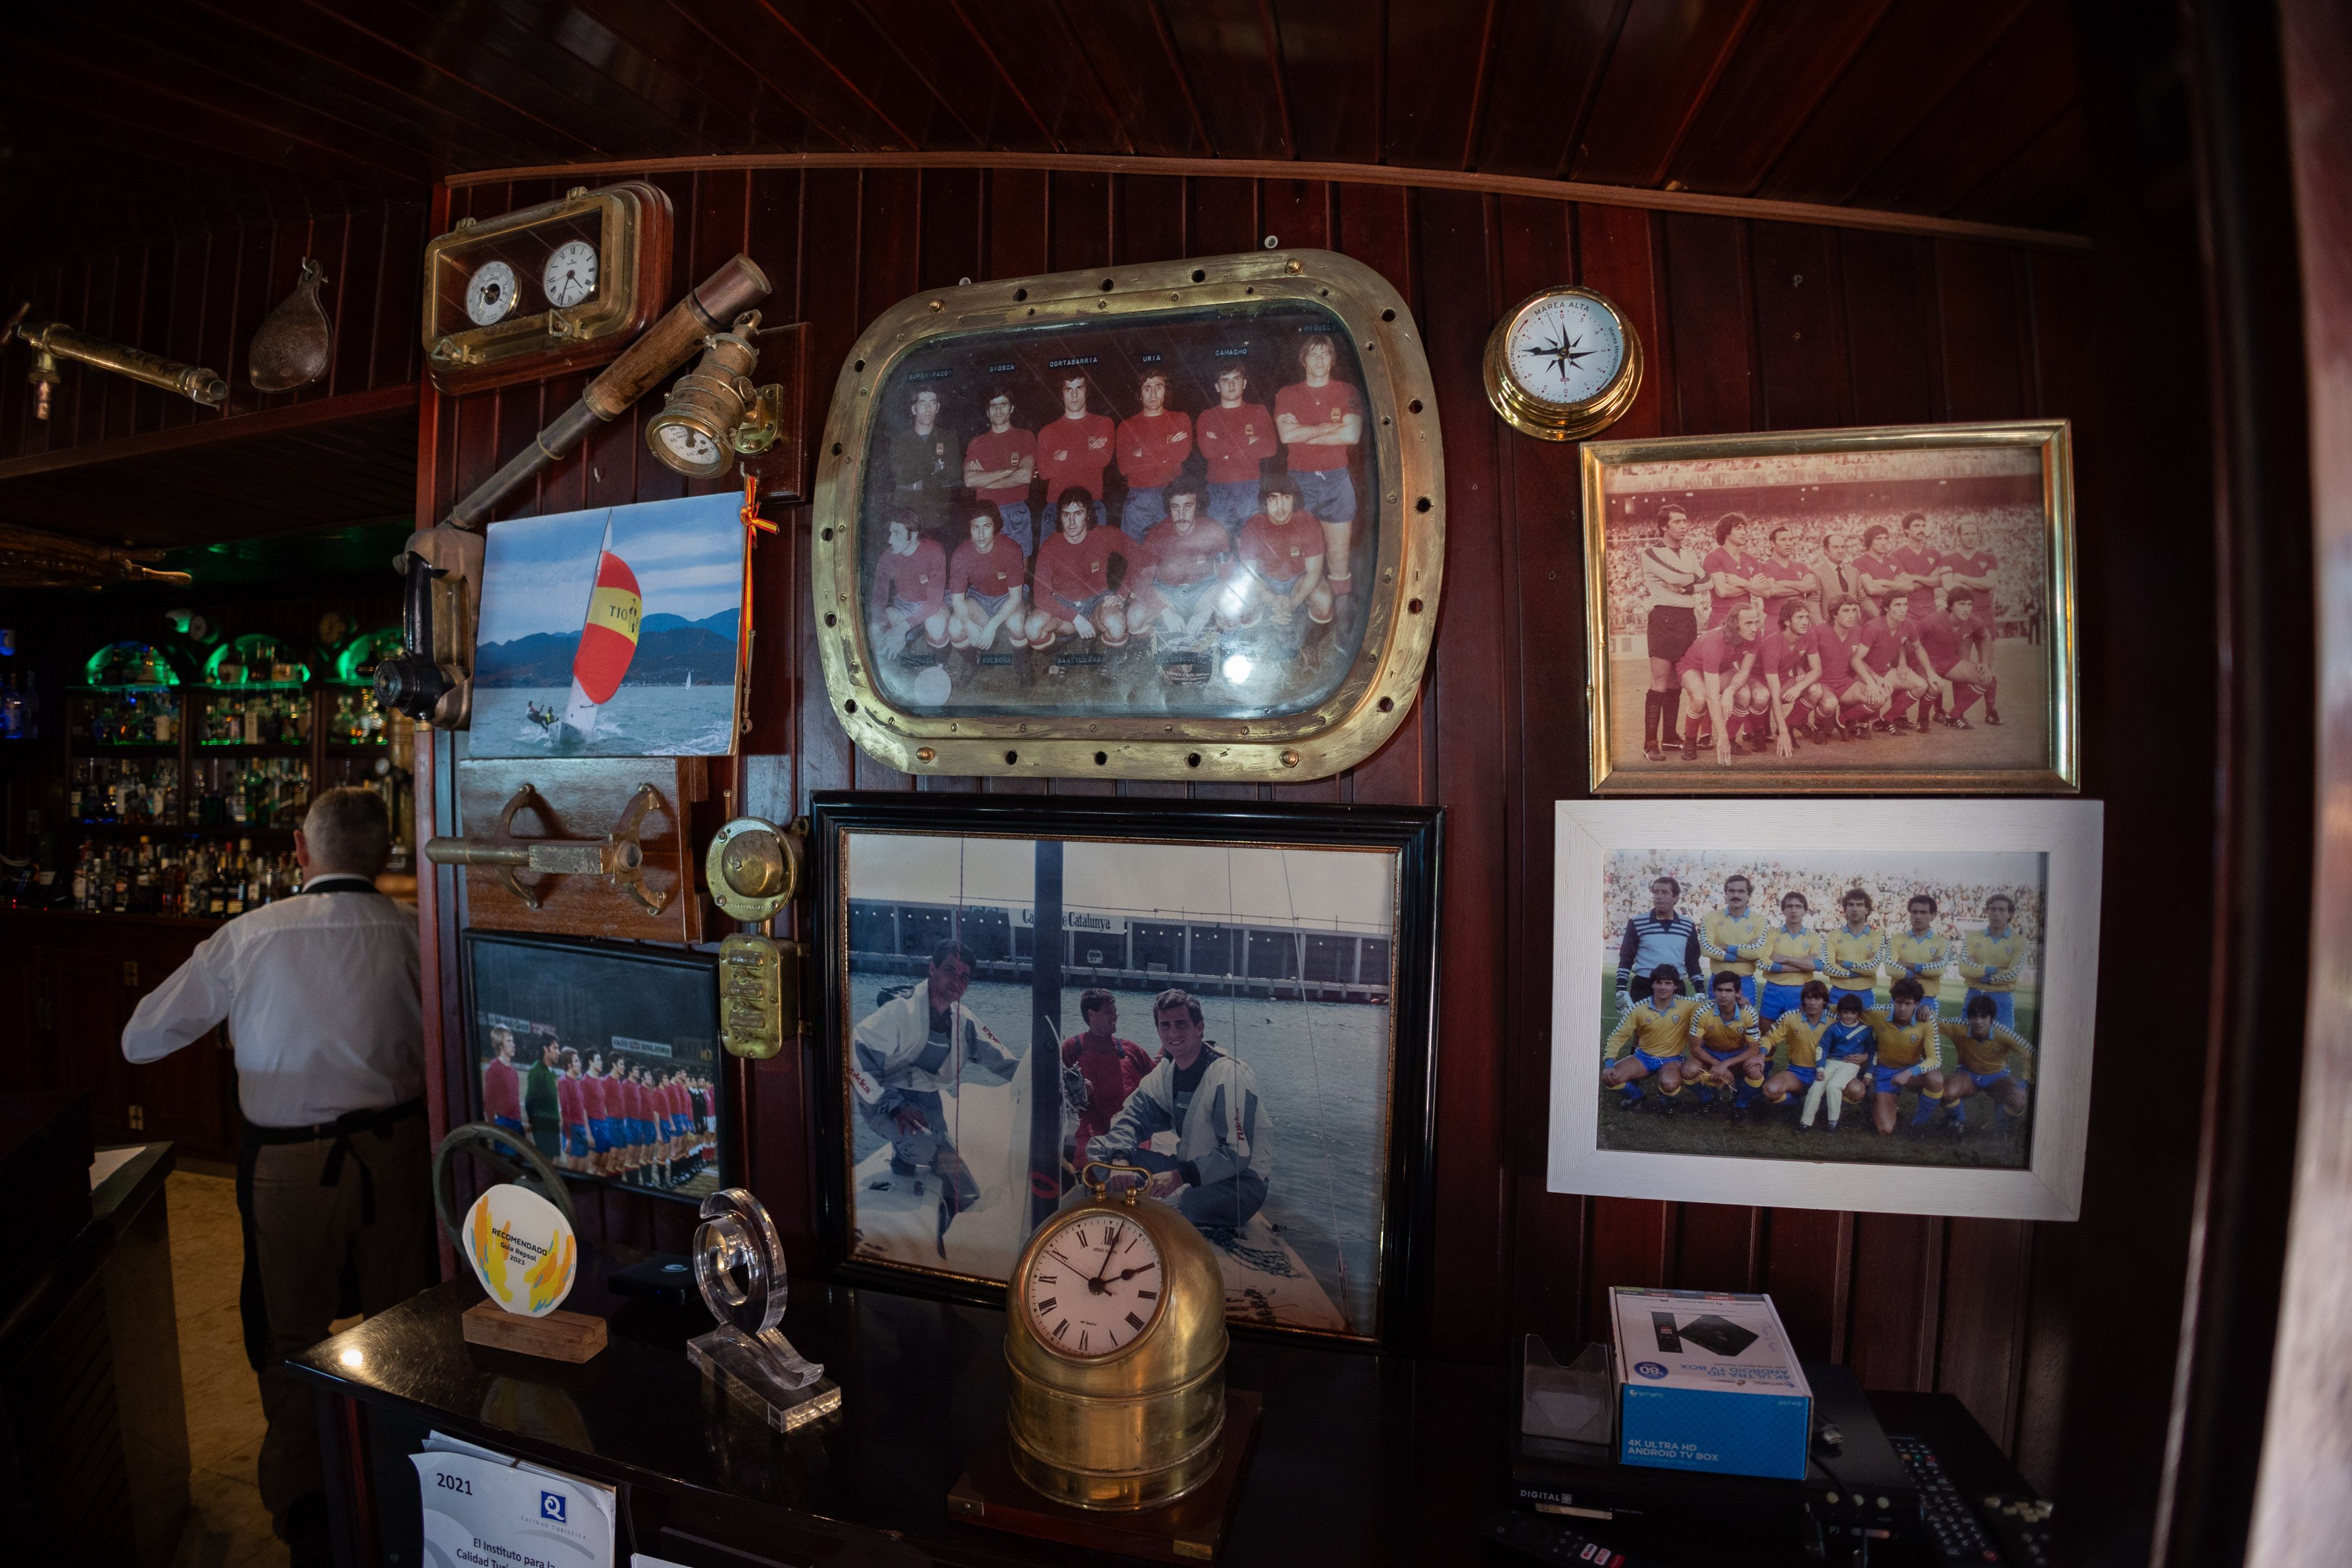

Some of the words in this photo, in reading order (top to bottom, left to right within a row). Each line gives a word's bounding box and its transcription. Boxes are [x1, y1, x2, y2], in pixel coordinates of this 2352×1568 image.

[1534, 302, 1565, 316] MAREA
[1568, 302, 1589, 312] ALTA
[1608, 327, 1618, 345] Marea
[1509, 336, 1519, 363] Creciente
[1050, 357, 1098, 367] CORTABARRIA
[1608, 346, 1620, 379] Menguante
[1512, 364, 1521, 380] Marea
[609, 605, 628, 621] TIO
[1068, 912, 1111, 932] Catalunya
[492, 1228, 547, 1256] RECOMENDADO
[500, 1242, 514, 1252] Guía
[516, 1248, 536, 1262] Repsol
[510, 1255, 525, 1265] 2023
[1628, 1439, 1642, 1447] 4K
[1644, 1440, 1679, 1450] ULTRA
[1682, 1443, 1697, 1452] HD
[1628, 1447, 1677, 1458] ANDROID
[1679, 1451, 1693, 1459] TV
[1696, 1453, 1719, 1462] BOX
[436, 1473, 473, 1496] 2021
[1520, 1489, 1561, 1501] DIGITAL
[521, 1516, 549, 1528] CALIDAD
[456, 1548, 489, 1567] Calidad
[473, 1537, 481, 1549] El
[484, 1541, 522, 1562] Instituto
[524, 1556, 544, 1568] para
